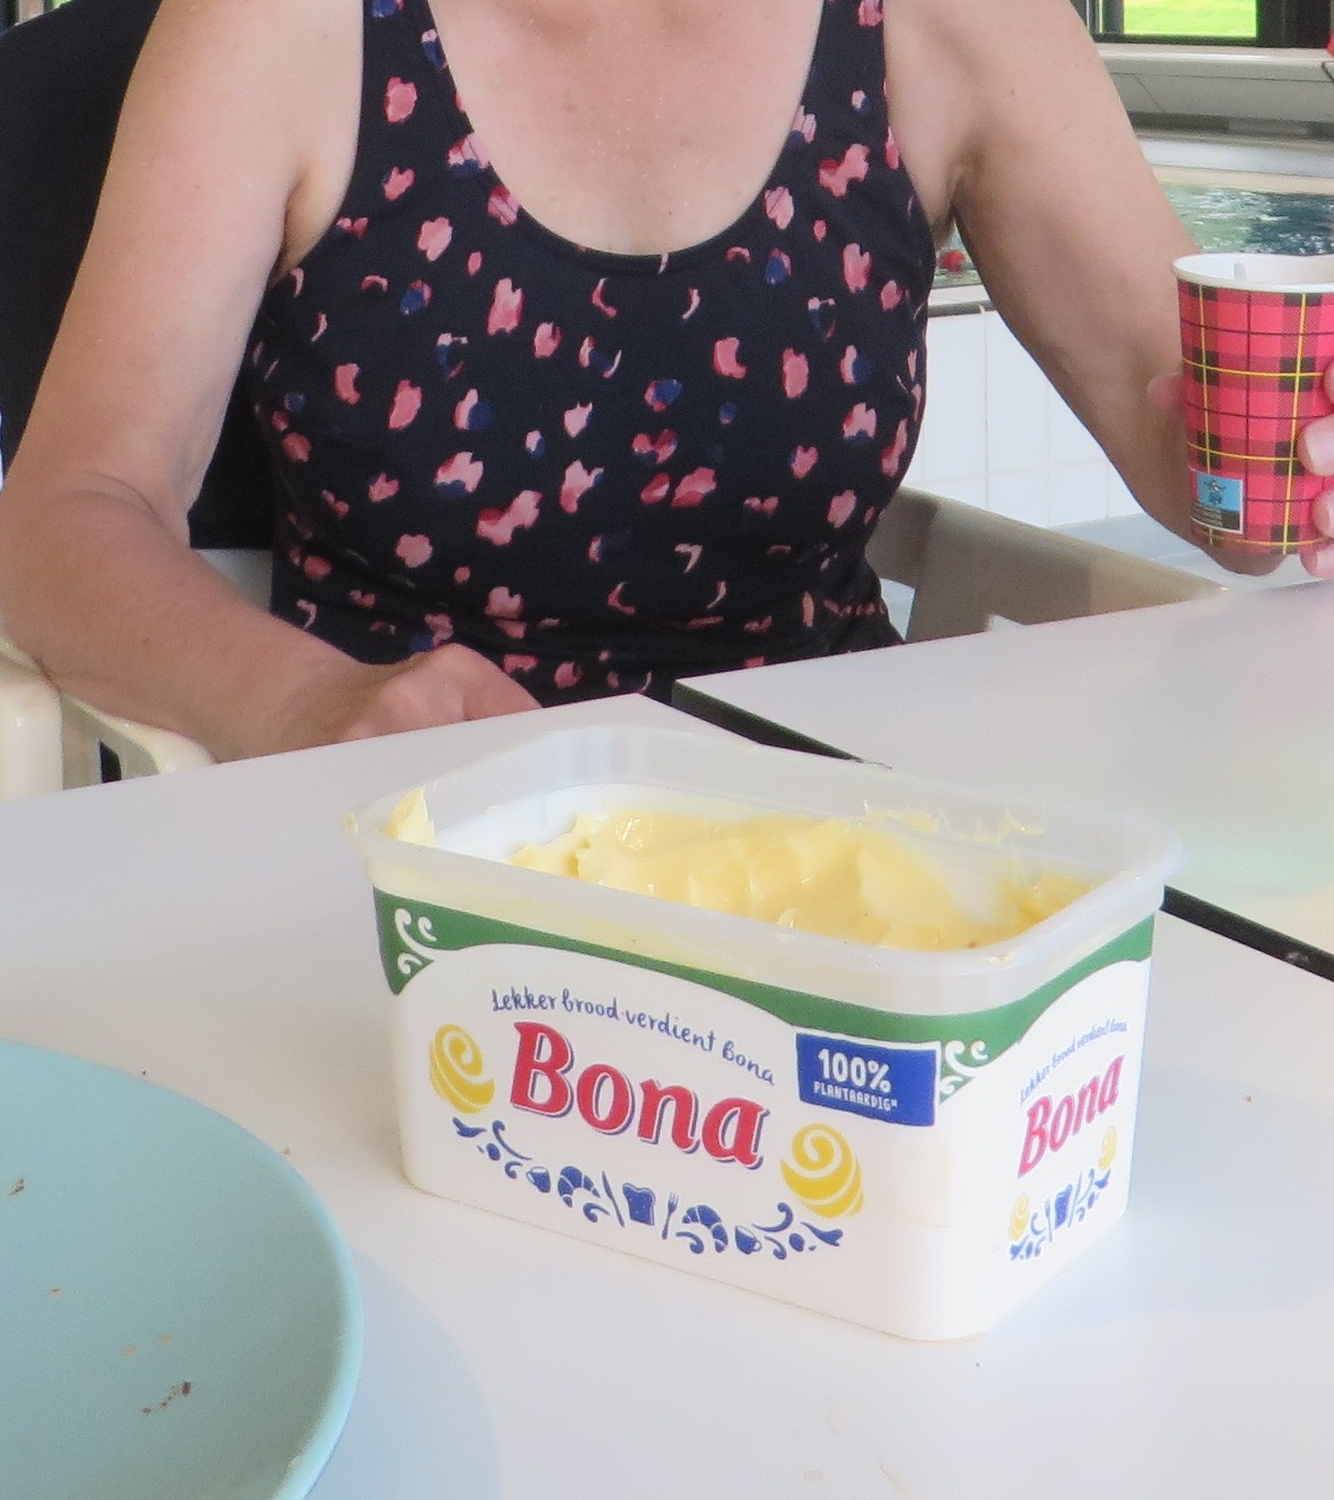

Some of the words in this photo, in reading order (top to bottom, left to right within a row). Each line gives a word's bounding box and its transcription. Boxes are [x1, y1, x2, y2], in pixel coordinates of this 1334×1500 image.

[492, 986, 557, 1012] Lekker
[561, 988, 620, 1021] brood
[625, 1010, 717, 1052] verdient
[510, 1021, 770, 1170] Bona
[818, 1048, 892, 1093] 100%
[1017, 1054, 1126, 1179] Bona
